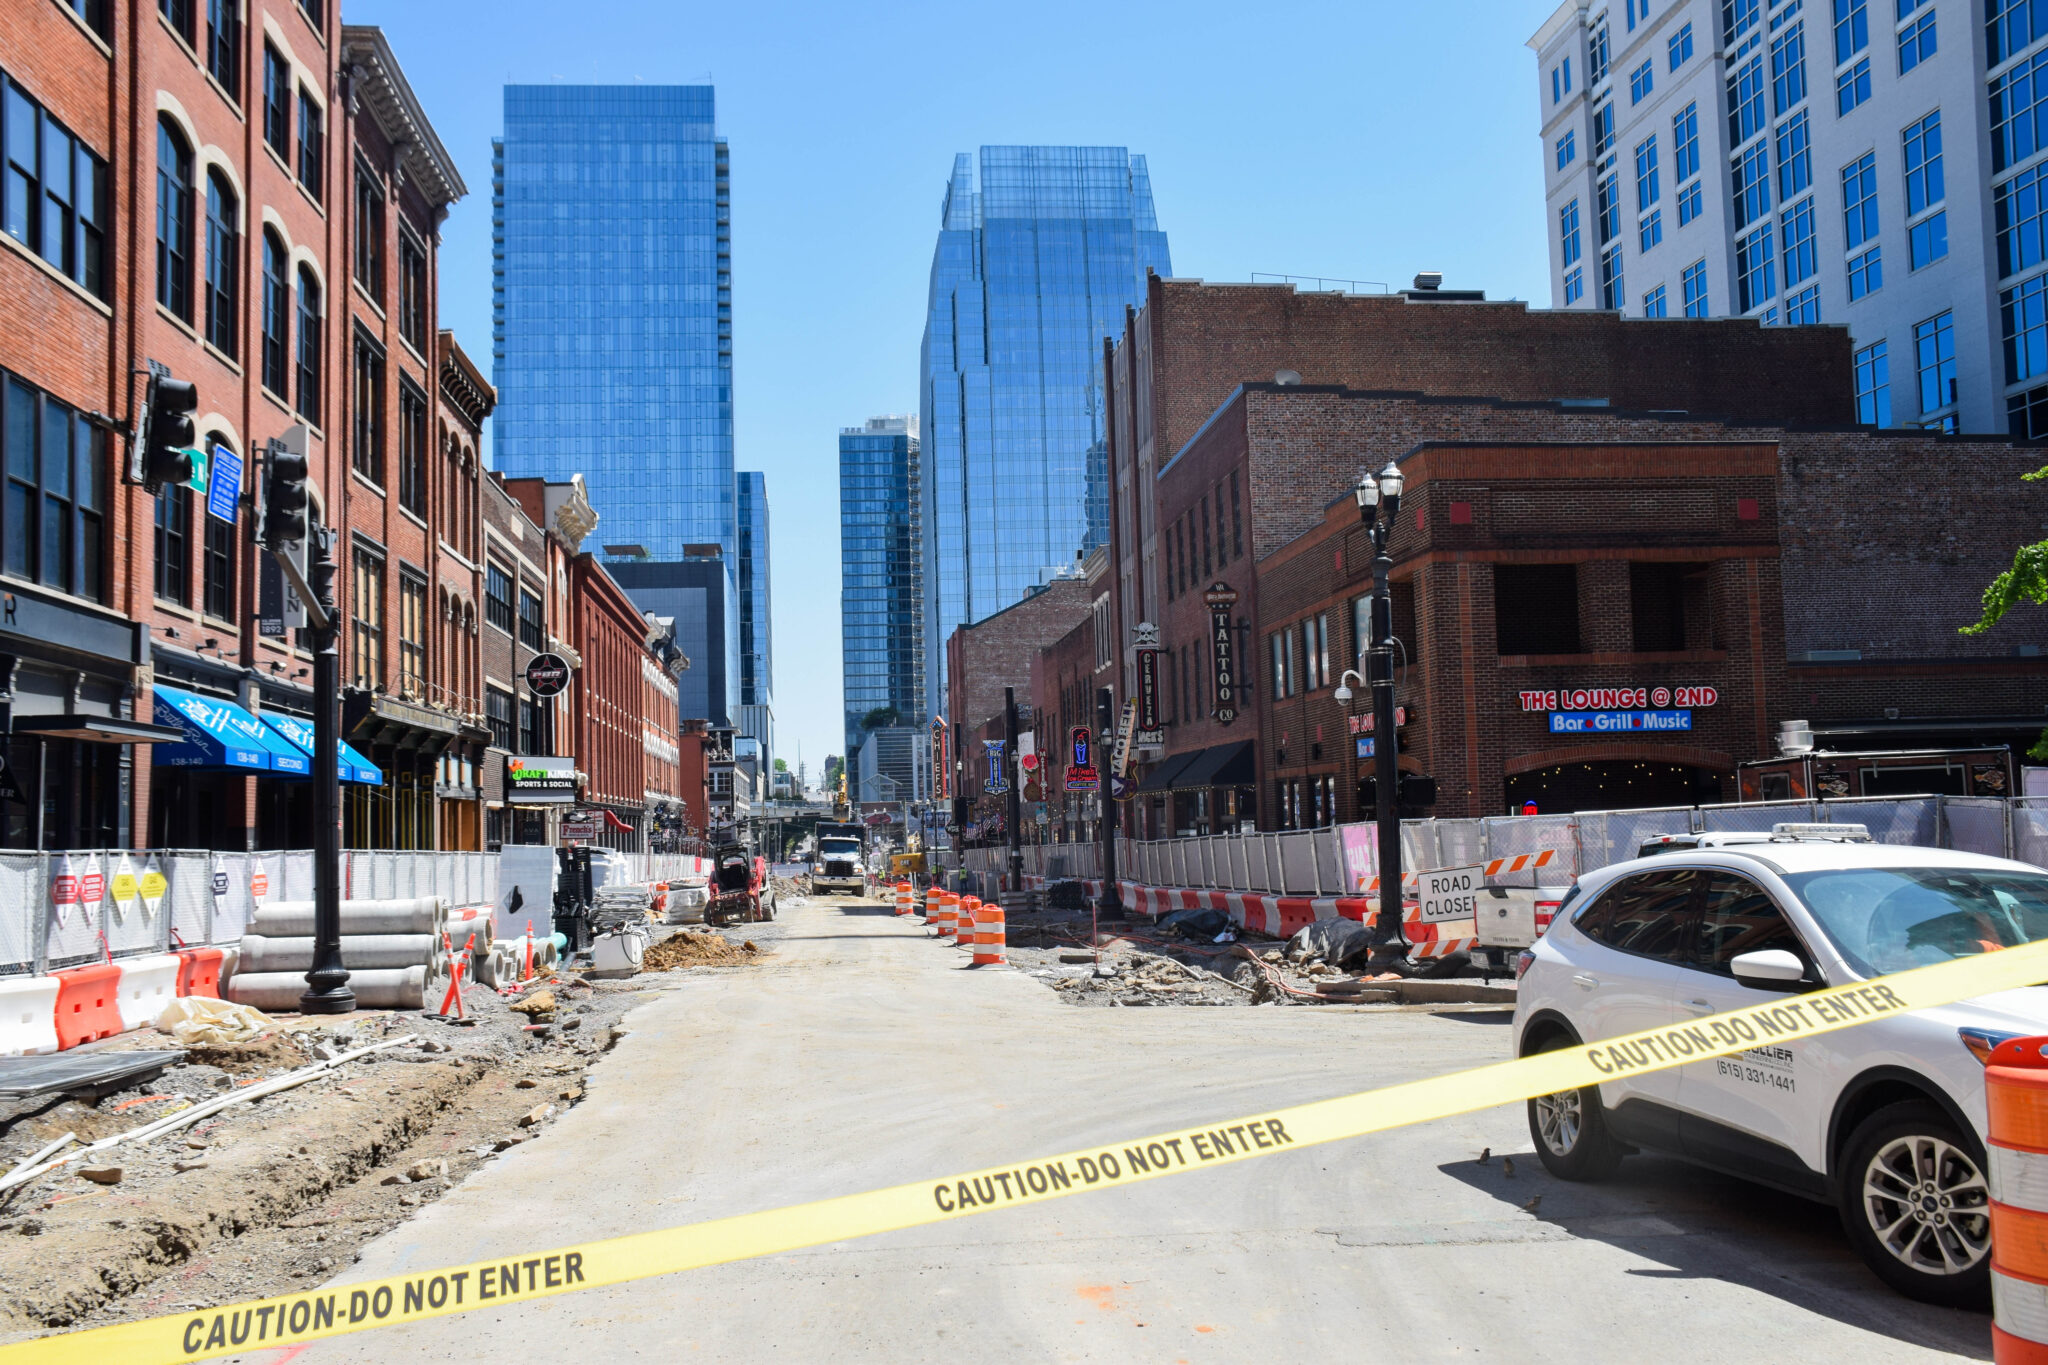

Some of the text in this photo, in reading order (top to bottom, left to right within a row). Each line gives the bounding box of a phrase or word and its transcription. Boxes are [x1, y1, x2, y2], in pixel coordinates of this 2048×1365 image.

[261, 625, 282, 634] 1892
[1215, 613, 1231, 701] TATTOO
[1520, 686, 1718, 711] THE LOUNGE @ 2ND
[1219, 708, 1234, 722] CO
[1360, 712, 1375, 732] LOU
[1394, 706, 1406, 727] ND
[1554, 712, 1688, 731] Bar Grill Music
[277, 757, 303, 770] SECOND
[933, 729, 943, 794] CHIEFS
[1111, 737, 1126, 776] TACO
[549, 780, 573, 788] SOCIAL
[563, 824, 592, 836] French's
[1431, 875, 1471, 894] ROAD
[1425, 896, 1476, 916] CLOSE
[1587, 984, 1907, 1074] CAUTION-DO NOT ENTER
[1744, 1045, 1793, 1062] OLLIER
[1716, 1059, 1744, 1081] (615)
[1745, 1067, 1796, 1094] 331-1441
[933, 1117, 1295, 1213] CAUTION-DO NOT ENTER
[182, 1251, 587, 1355] CAUTION-DO NOT ENTER
